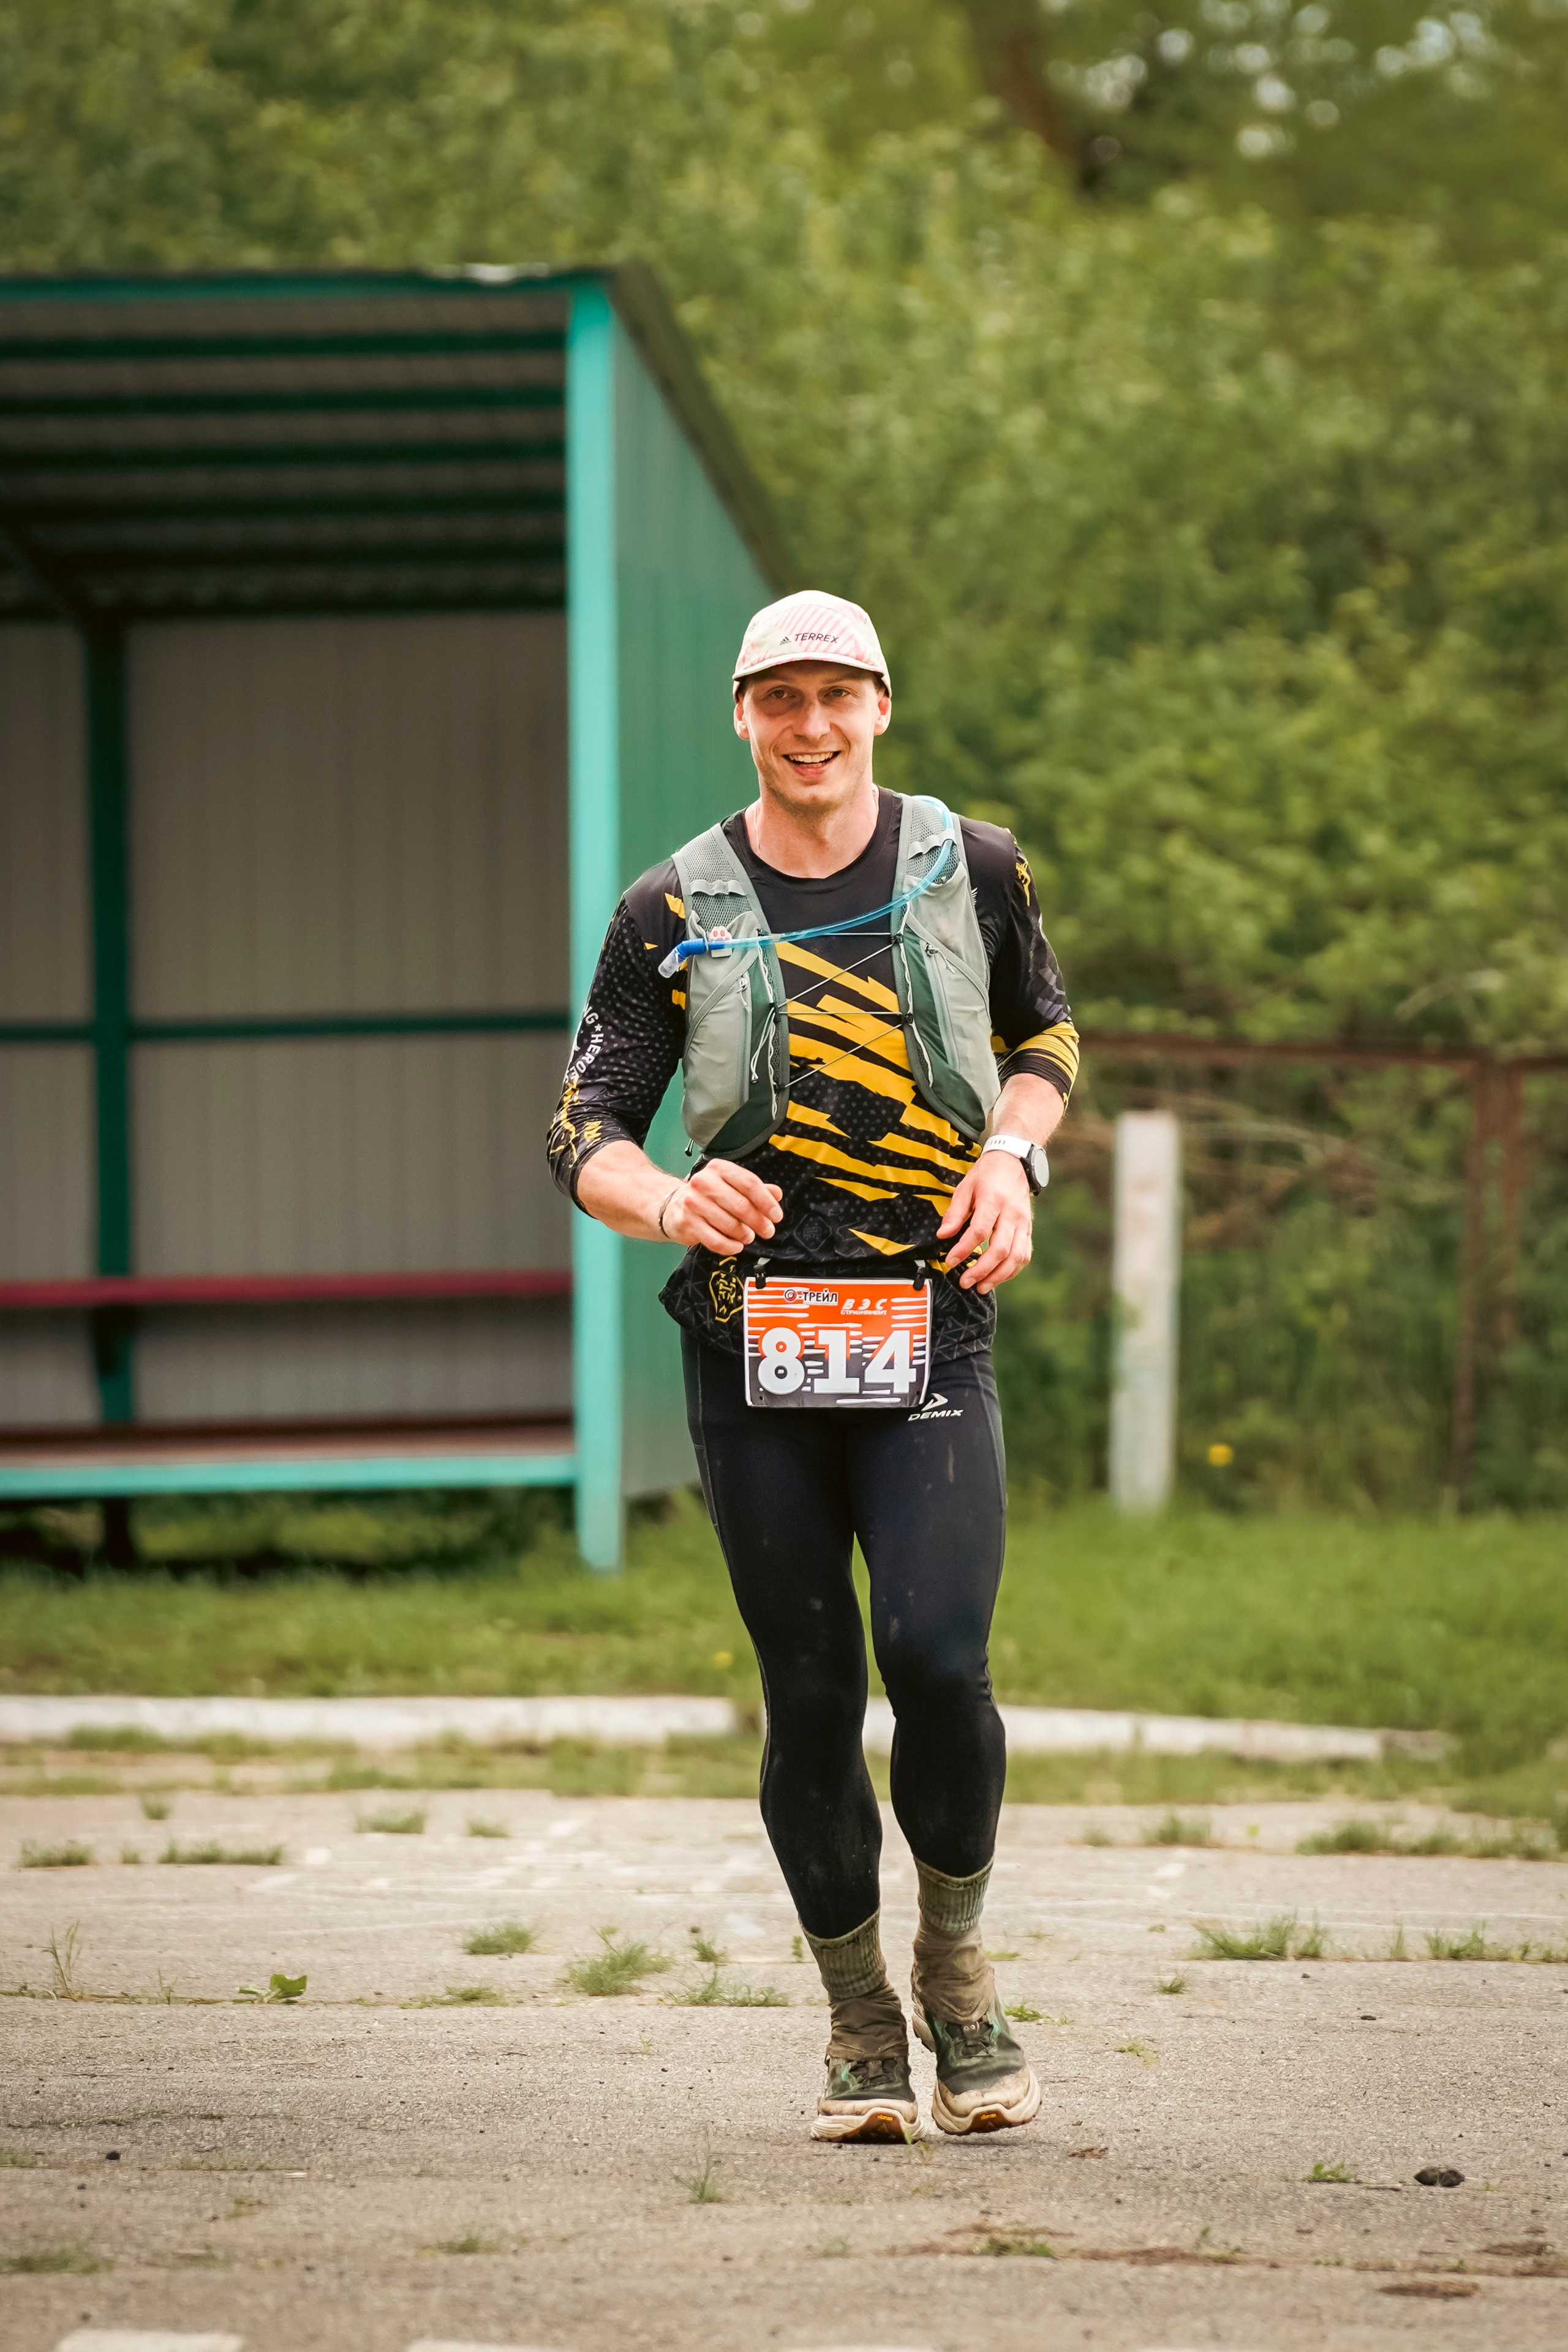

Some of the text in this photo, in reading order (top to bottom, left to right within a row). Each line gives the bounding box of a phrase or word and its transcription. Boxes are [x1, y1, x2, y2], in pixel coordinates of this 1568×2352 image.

[795, 632, 839, 644] TERREX
[758, 1327, 916, 1394] 814
[908, 1410, 963, 1421] DEMIX
